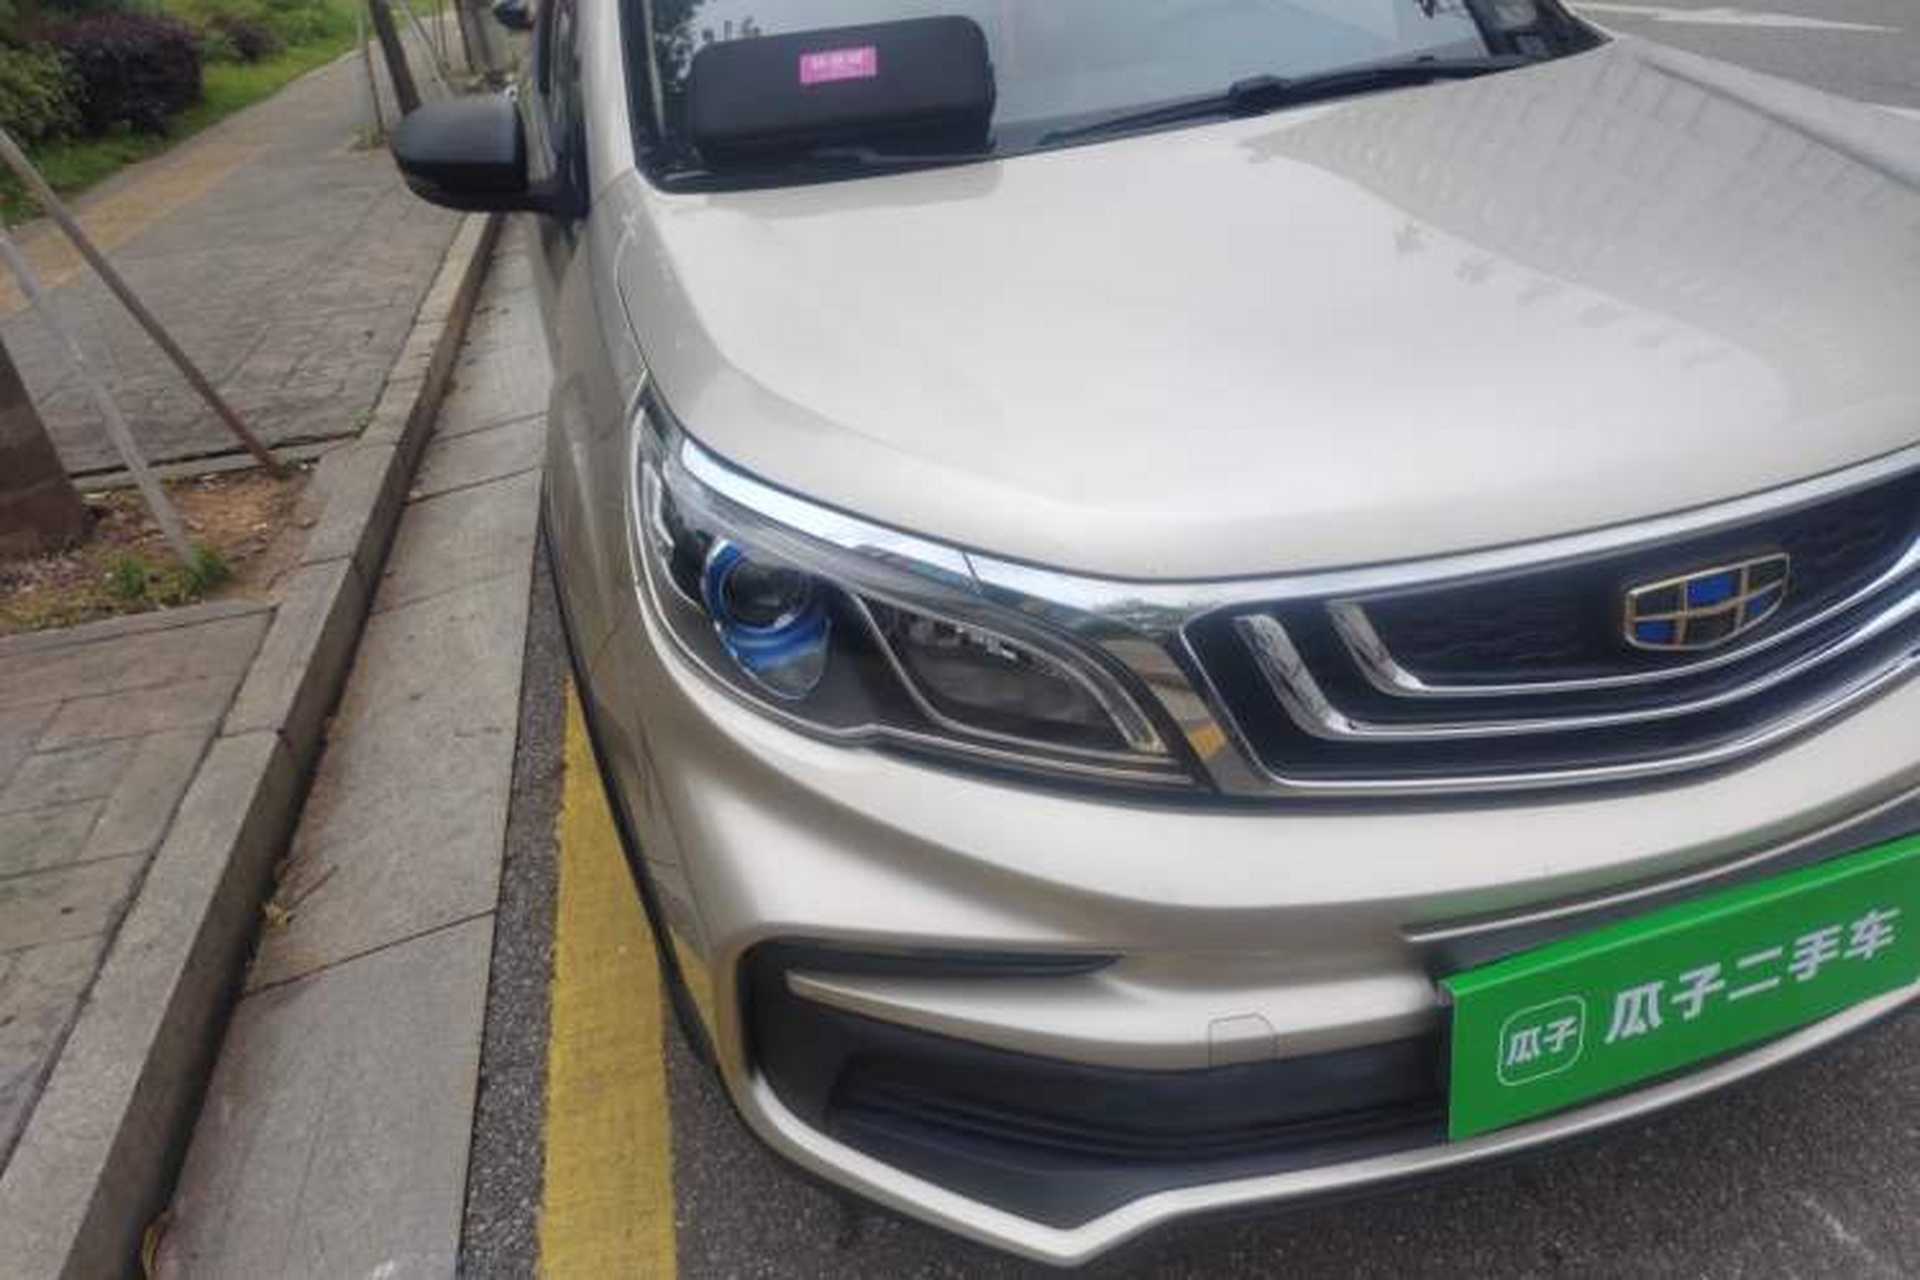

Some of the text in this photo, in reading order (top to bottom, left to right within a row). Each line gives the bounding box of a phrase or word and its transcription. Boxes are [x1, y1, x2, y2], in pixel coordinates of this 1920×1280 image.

[1605, 908, 1900, 1043] 瓜子二手车
[1506, 1016, 1577, 1066] 瓜子
